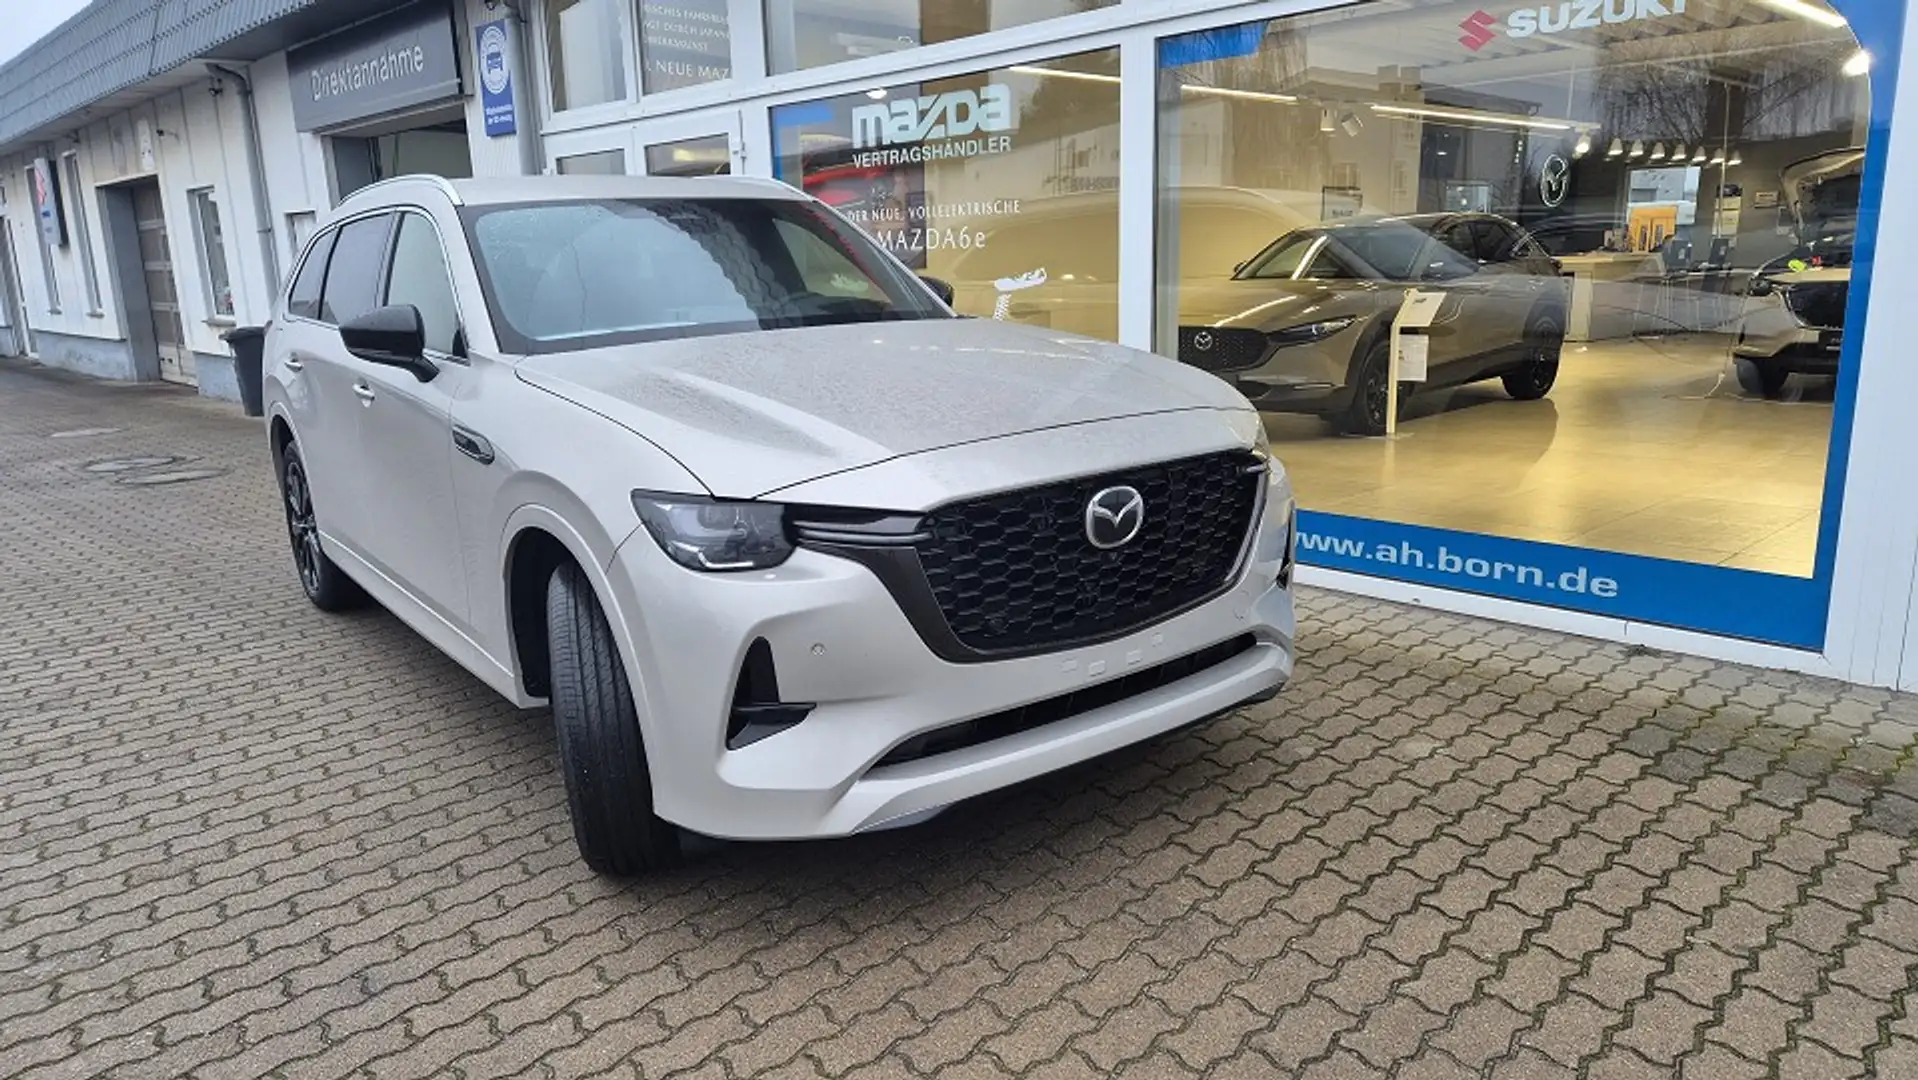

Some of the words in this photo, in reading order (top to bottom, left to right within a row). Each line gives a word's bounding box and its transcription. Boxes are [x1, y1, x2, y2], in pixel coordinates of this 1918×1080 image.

[309, 45, 424, 101] Direktannahme
[656, 60, 693, 78] NEUE
[852, 136, 1012, 169] VERTRAGSHÄNDLER
[908, 199, 1021, 220] VOLLELEKTRISCHE
